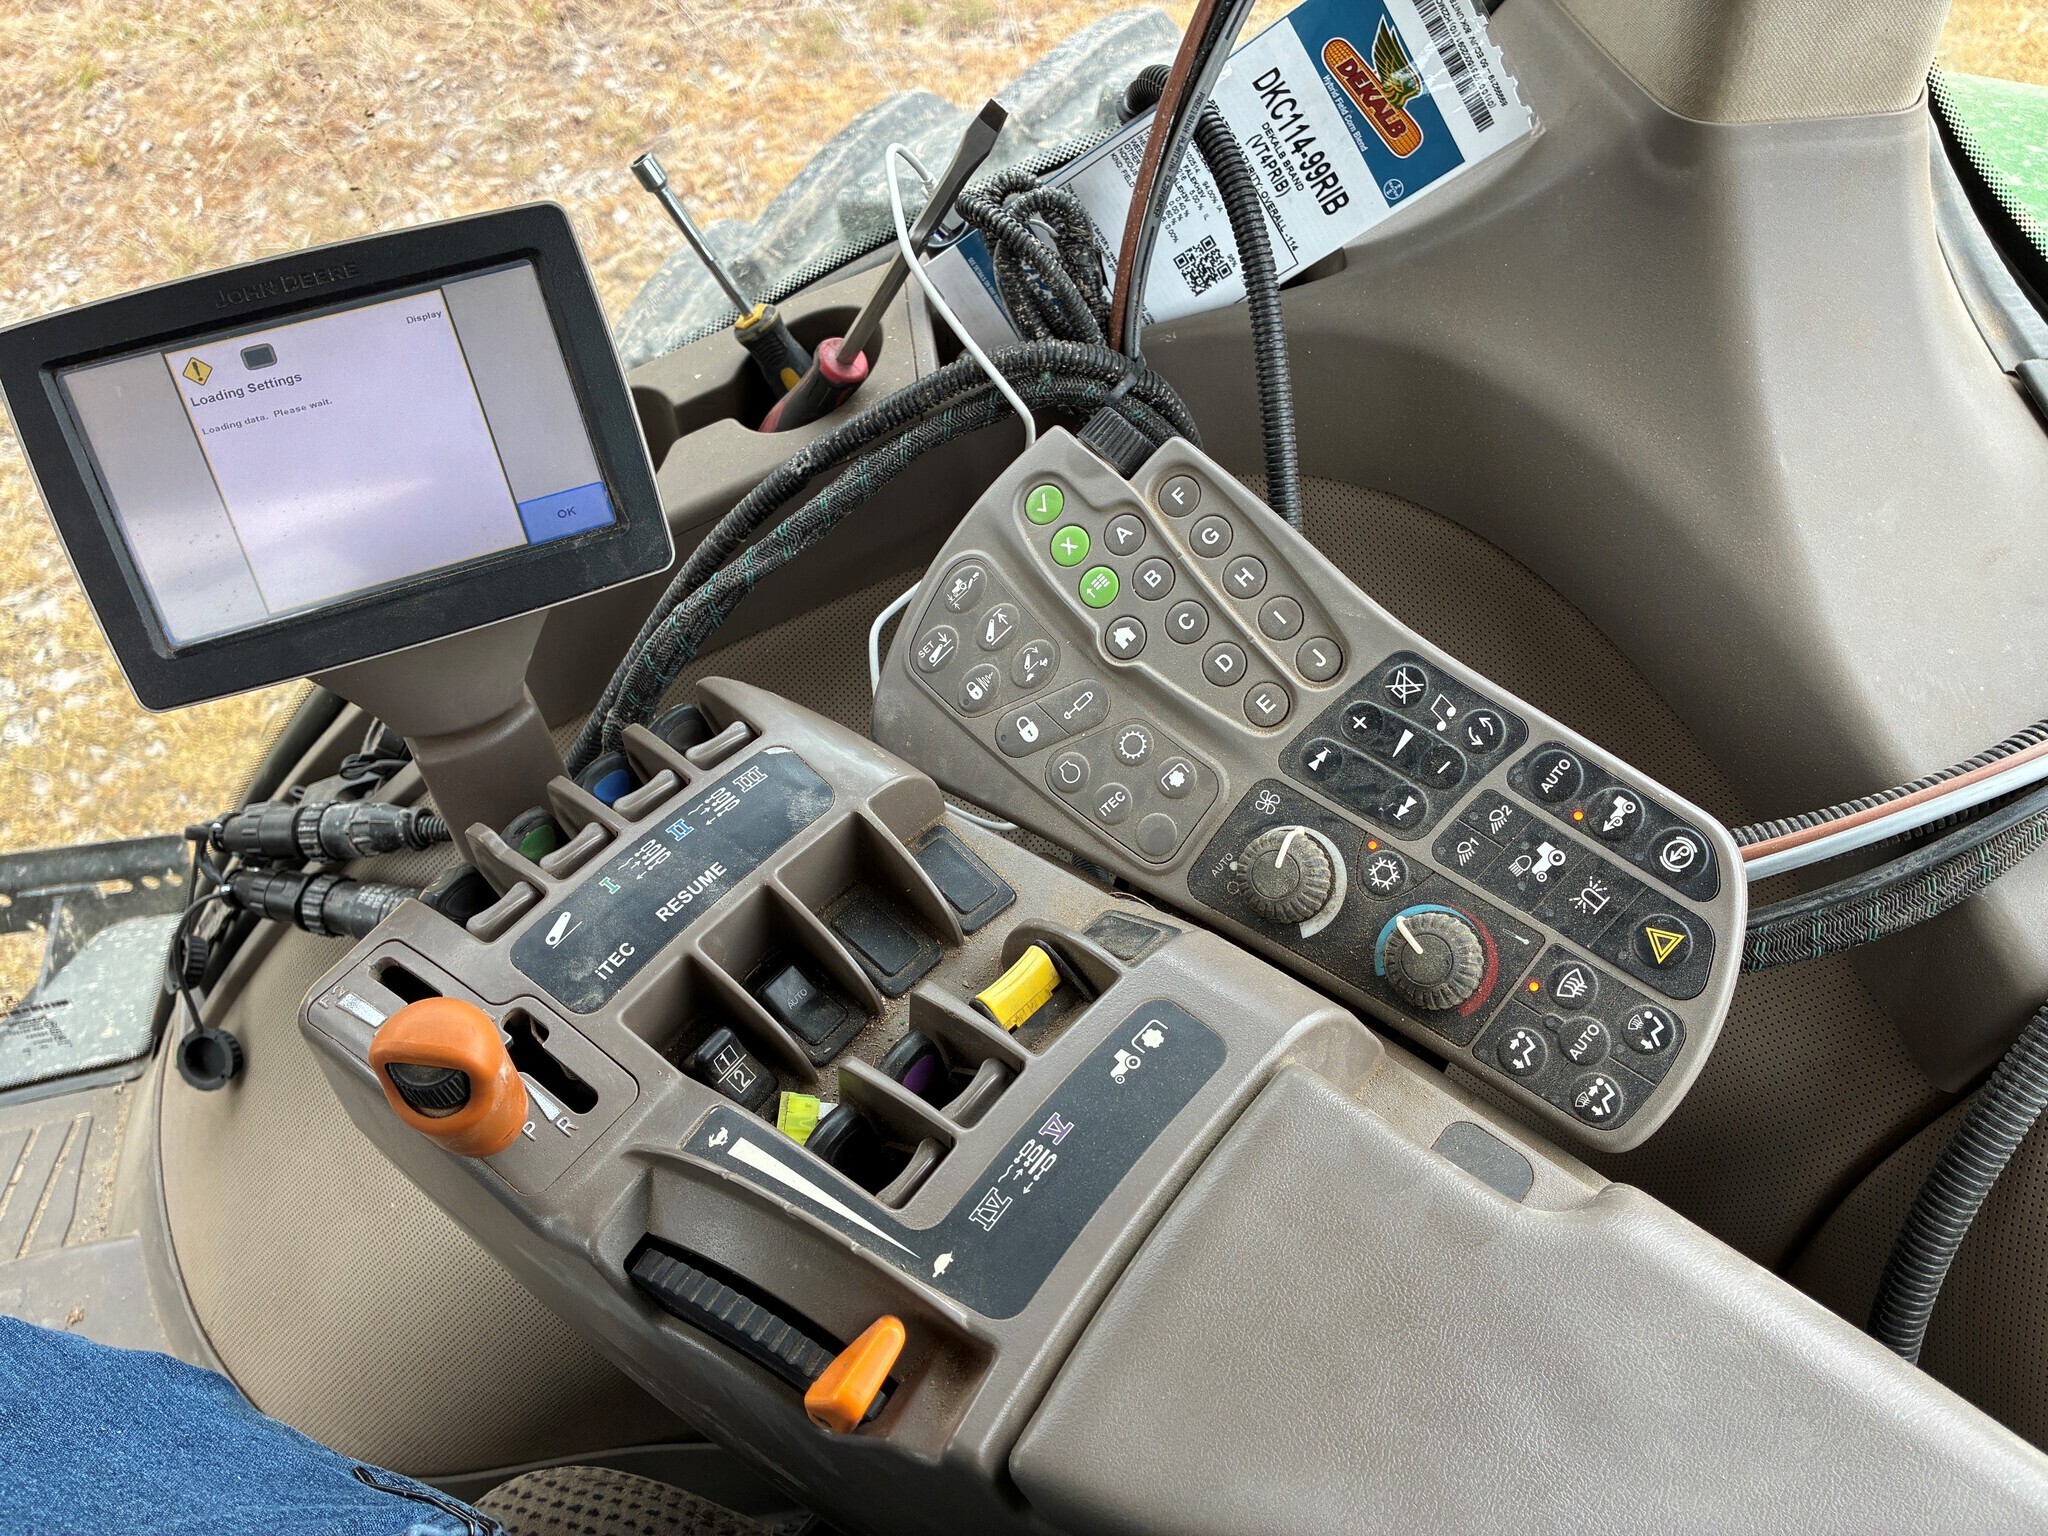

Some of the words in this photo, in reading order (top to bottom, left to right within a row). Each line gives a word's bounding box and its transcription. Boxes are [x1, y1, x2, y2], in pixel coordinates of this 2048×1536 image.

[1337, 57, 1407, 138] DEKALB
[1320, 74, 1339, 99] Hybrid
[1334, 97, 1349, 115] Field
[1343, 114, 1358, 132] Corn
[1351, 130, 1368, 152] Blend
[1252, 67, 1351, 217] DKC114-99RIB
[1117, 147, 1138, 176] NOXIOUS
[1123, 143, 1141, 166] OTHER
[1246, 132, 1292, 197] (VT4PRIB)
[1260, 121, 1287, 159] DEKALB
[1282, 159, 1304, 192] BRAND
[1120, 169, 1136, 188] FIELD
[1172, 177, 1190, 203] ALEH3V
[1259, 190, 1287, 232] OVERALL
[1283, 231, 1298, 251] -114
[214, 281, 276, 308] JOHN
[280, 264, 359, 292] DEERE
[406, 311, 442, 323] Display
[190, 387, 244, 406] Loading
[247, 373, 302, 392] Settings
[202, 419, 242, 435] Loading
[244, 413, 268, 424] data.
[273, 405, 305, 417] Please
[310, 399, 332, 408] wait.
[1171, 487, 1188, 505] F
[557, 505, 576, 517] OK
[1114, 525, 1135, 545] A
[1201, 526, 1219, 546] G
[1144, 569, 1163, 588] B
[1234, 566, 1255, 588] H
[1178, 612, 1196, 631] C
[1274, 611, 1287, 625] I
[918, 640, 935, 659] SET
[1312, 649, 1328, 668] J
[1214, 653, 1233, 674] D
[1256, 693, 1277, 715] E
[1541, 759, 1571, 793] AUTO
[1099, 791, 1125, 817] iTEC
[1211, 852, 1233, 876] AUTO
[655, 861, 729, 923] RESUME
[594, 941, 637, 981] iTEC
[788, 988, 807, 1010] AUTO
[1569, 1024, 1600, 1061] AUTO
[522, 1121, 536, 1141] P
[556, 1117, 578, 1137] R
